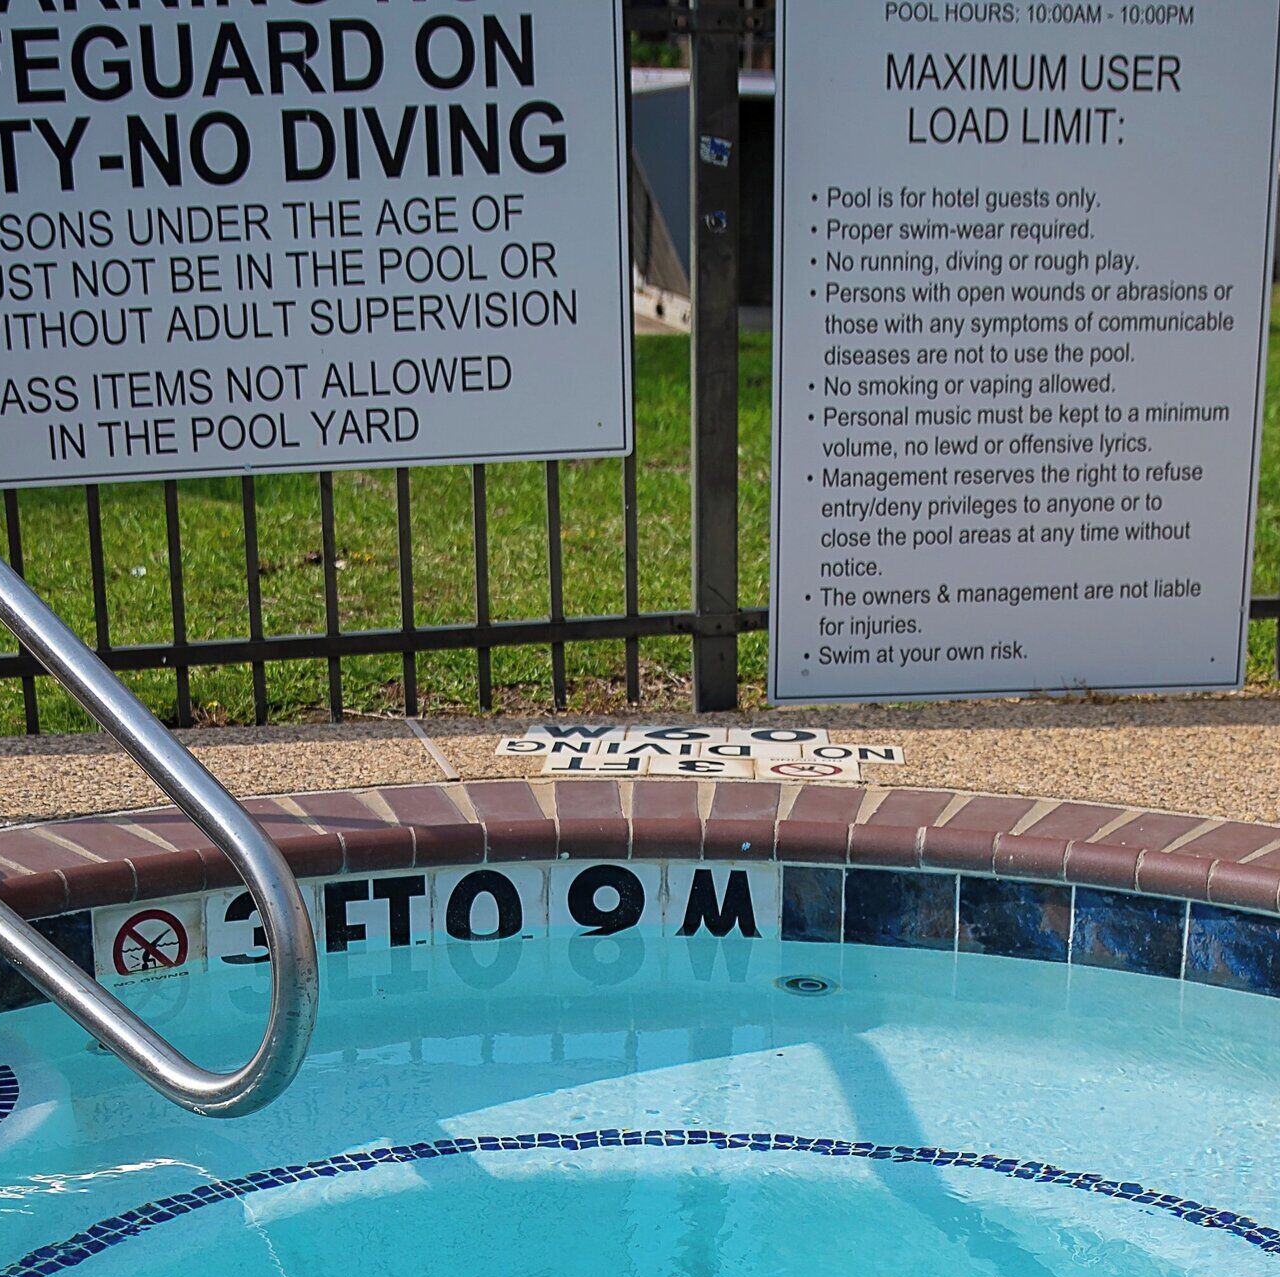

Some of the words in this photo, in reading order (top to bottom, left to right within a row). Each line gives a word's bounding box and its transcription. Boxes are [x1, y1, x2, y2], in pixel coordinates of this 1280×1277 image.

[885, 1, 938, 22] POOL
[945, 2, 1019, 23] HOURS:
[1027, 3, 1101, 23] 10:00AM
[1120, 4, 1193, 24] 10:00PM
[414, 13, 534, 90] ON
[886, 52, 1067, 91] MAXIMUM
[1081, 54, 1180, 92] USER
[281, 100, 566, 182] DIVING
[909, 106, 1008, 144] LOAD
[1022, 107, 1124, 144] LIMIT:
[827, 186, 871, 208] Pool
[878, 187, 893, 207] is
[900, 186, 926, 208] for
[932, 187, 979, 208] hotel
[985, 188, 1049, 213] guests
[1056, 187, 1100, 213] only.
[127, 203, 271, 246] UNDER
[282, 199, 362, 239] THE
[375, 196, 458, 236] AGE
[472, 193, 524, 232] OF
[827, 218, 893, 245] Proper
[899, 219, 1004, 239] swim-wear
[1010, 219, 1094, 244] required.
[71, 257, 155, 298] NOT
[169, 255, 222, 293] BE
[236, 252, 272, 290] IN
[285, 249, 365, 288] THE
[379, 244, 487, 284] POOL
[500, 241, 557, 279] OR
[826, 251, 854, 271] No
[861, 251, 938, 276] running,
[946, 250, 1002, 275] diving
[1009, 254, 1028, 270] or
[1034, 250, 1088, 275] rough
[1095, 250, 1139, 275] play.
[166, 300, 296, 343] ADULT
[310, 288, 576, 336] SUPERVISION
[92, 368, 213, 410] ITEMS
[226, 363, 308, 403] NOT
[321, 355, 511, 399] ALLOWED
[48, 423, 86, 460] IN
[97, 418, 178, 457] THE
[191, 412, 300, 452] POOL
[310, 406, 419, 446] YARD
[818, 645, 869, 665] Swim
[876, 645, 893, 663] at
[900, 647, 941, 667] your
[946, 646, 984, 661] own
[990, 640, 1027, 659] risk.
[506, 740, 752, 758] DIVING
[551, 757, 642, 772] FT
[813, 746, 894, 761] NO
[678, 760, 725, 773] 3
